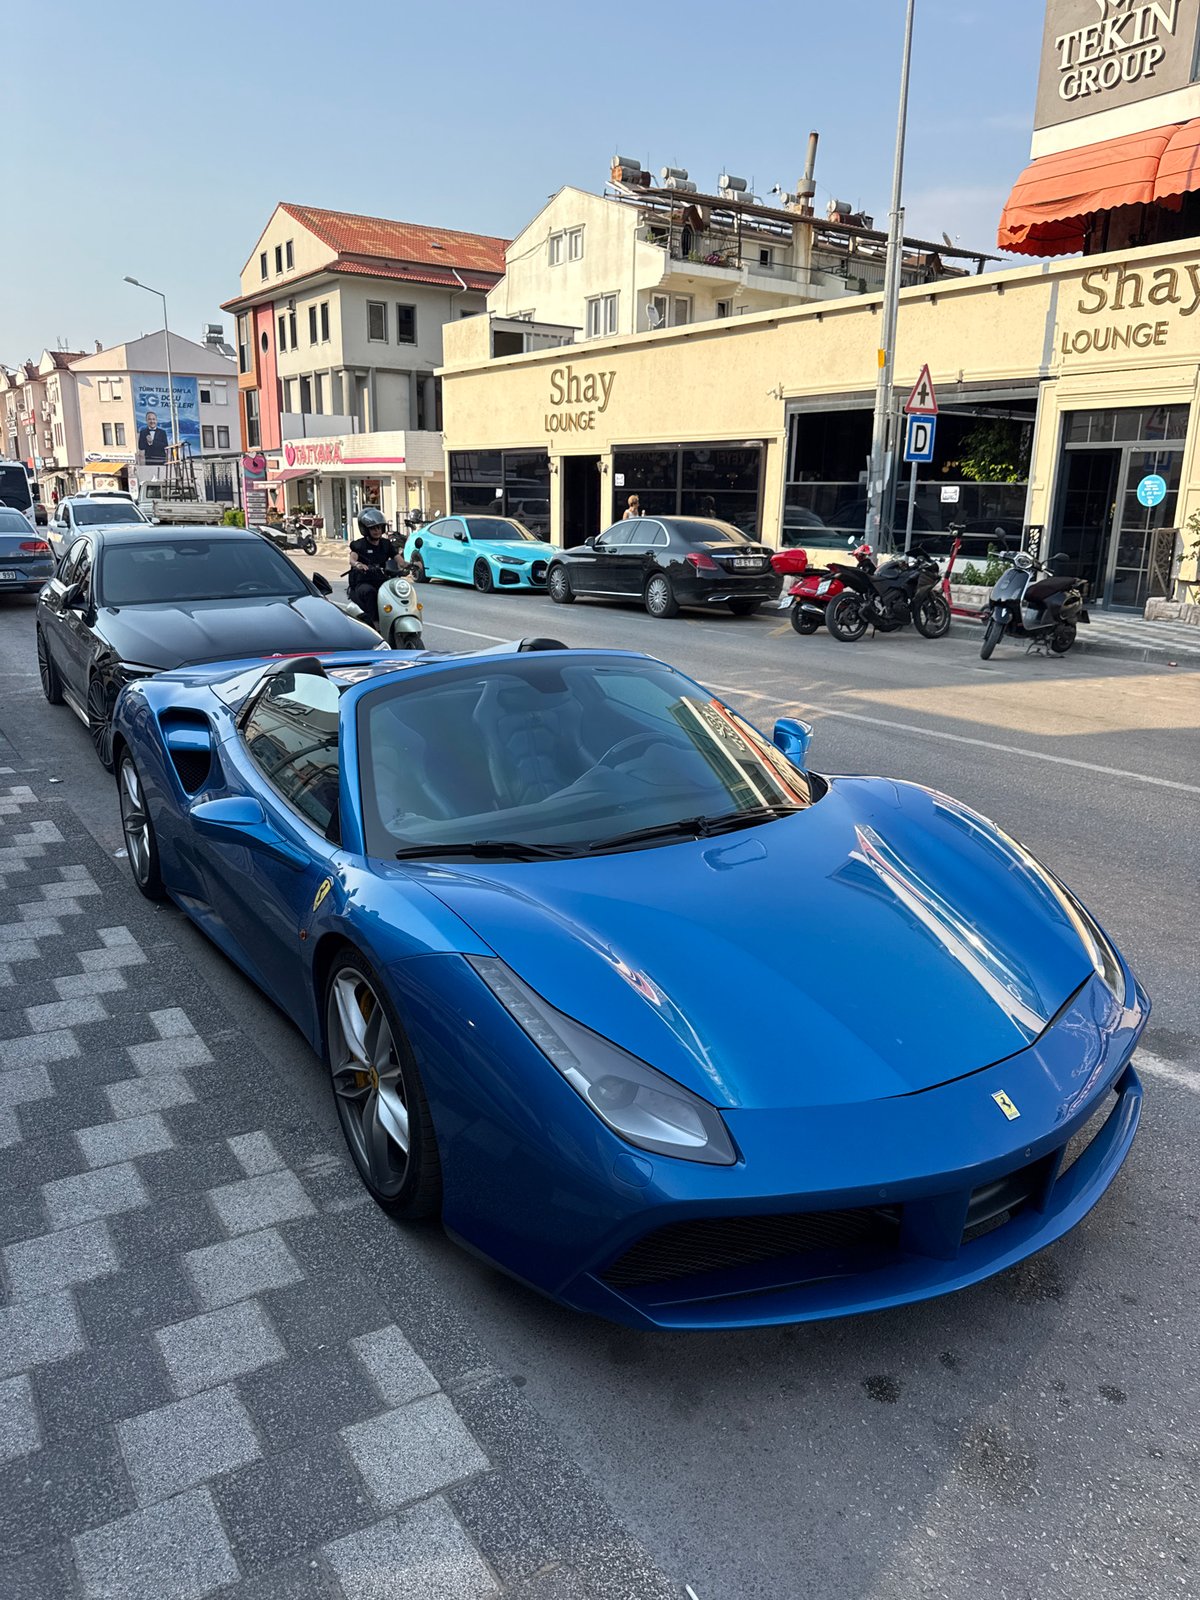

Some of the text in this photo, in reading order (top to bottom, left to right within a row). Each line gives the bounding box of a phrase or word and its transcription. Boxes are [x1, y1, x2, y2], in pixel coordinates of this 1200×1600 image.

[1058, 44, 1165, 102] GROUP
[1061, 321, 1169, 354] LOUNGE
[139, 393, 160, 407] 5G
[550, 365, 617, 413] Shay
[544, 410, 596, 433] LOUNGE
[913, 425, 928, 453] D
